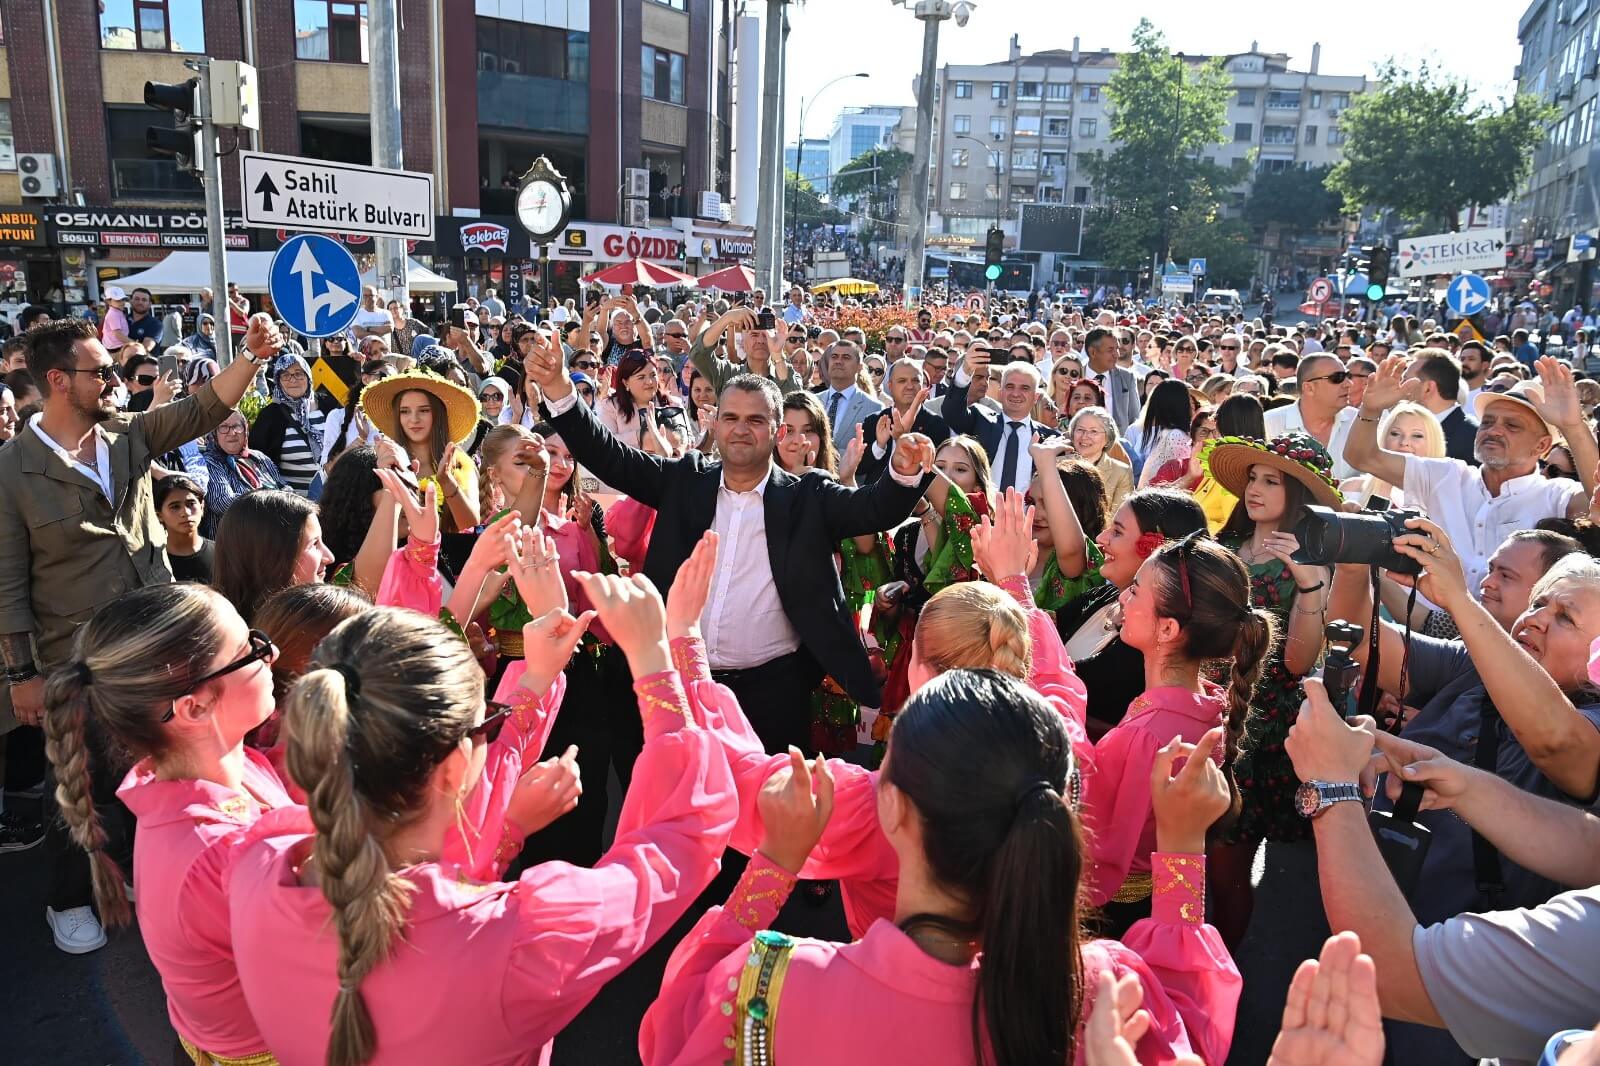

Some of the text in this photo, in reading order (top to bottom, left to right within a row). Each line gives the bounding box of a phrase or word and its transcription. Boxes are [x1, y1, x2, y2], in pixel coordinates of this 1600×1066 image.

[284, 169, 337, 194] Sahil
[55, 211, 247, 230] OSMANLI DÖER
[286, 197, 424, 227] Atatürk Bulvarı
[0, 226, 35, 241] TUNİ
[62, 234, 95, 243] SOSLU
[603, 231, 678, 260] GÖZDE
